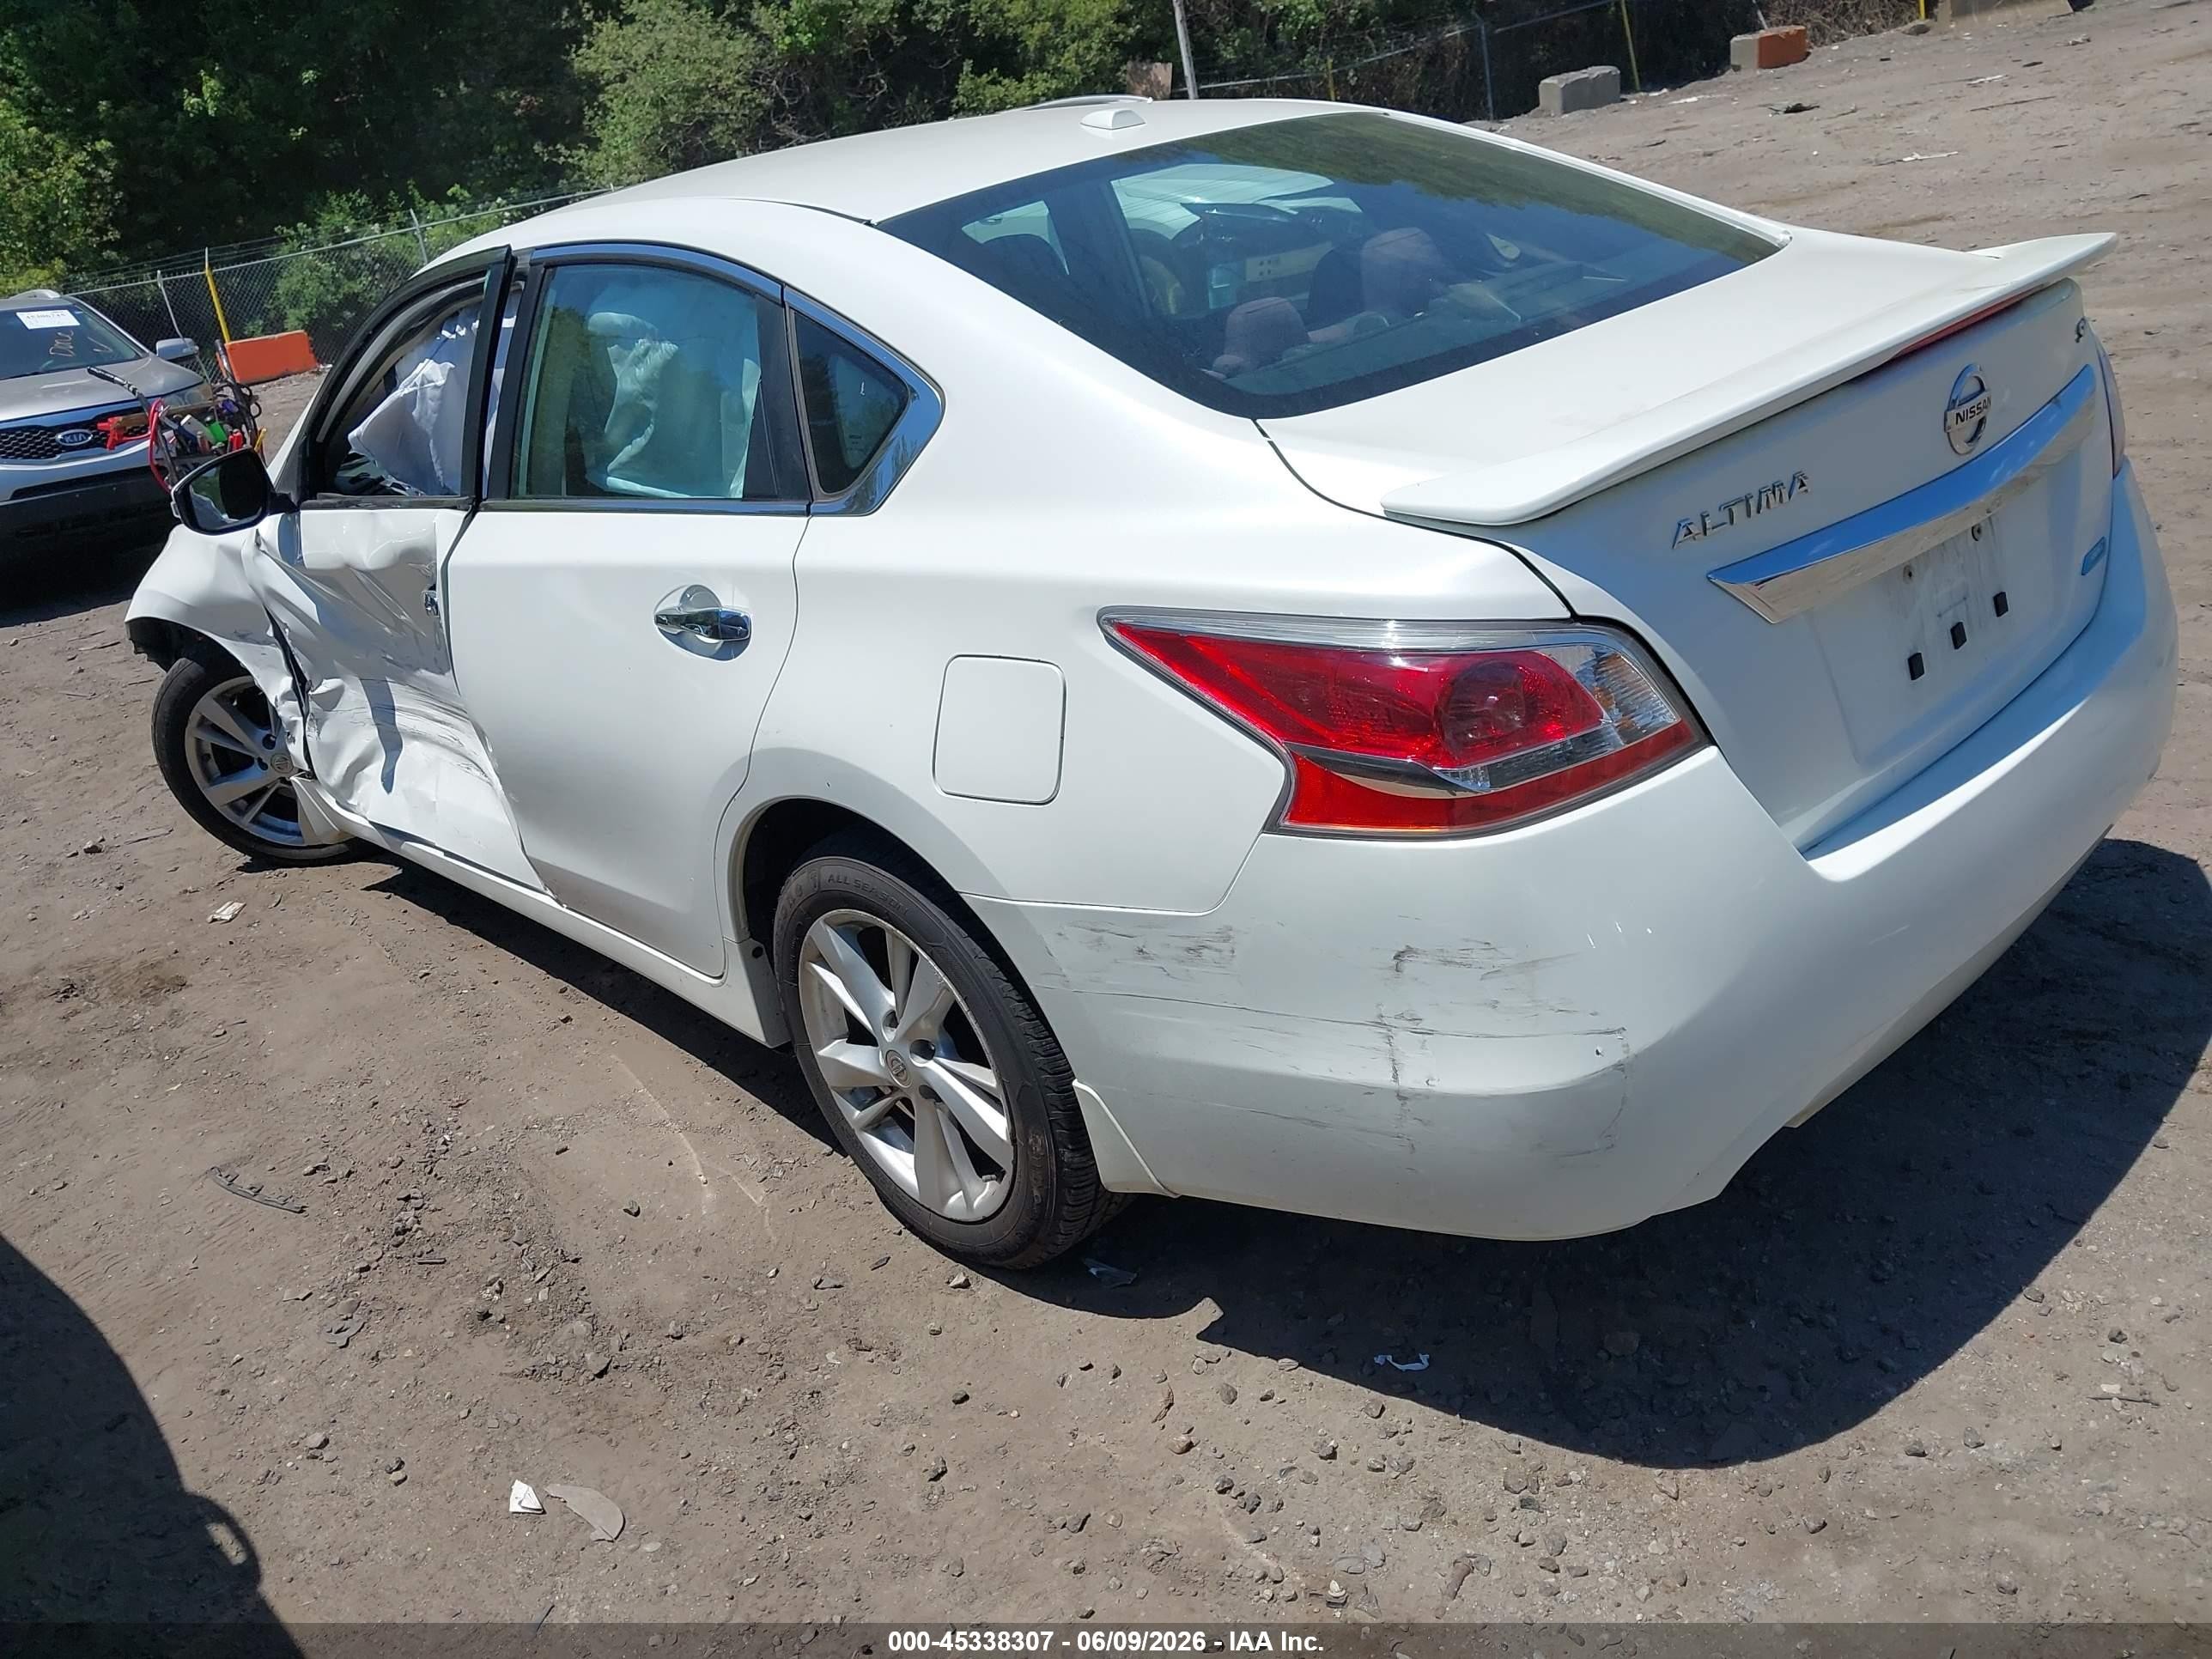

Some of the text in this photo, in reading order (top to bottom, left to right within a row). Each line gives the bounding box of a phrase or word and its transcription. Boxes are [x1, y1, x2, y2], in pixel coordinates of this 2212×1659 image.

[1955, 396, 1991, 425] NISSAN
[64, 433, 87, 444] KIA
[1671, 471, 1810, 550] ALTIMA
[827, 873, 850, 885] ALL
